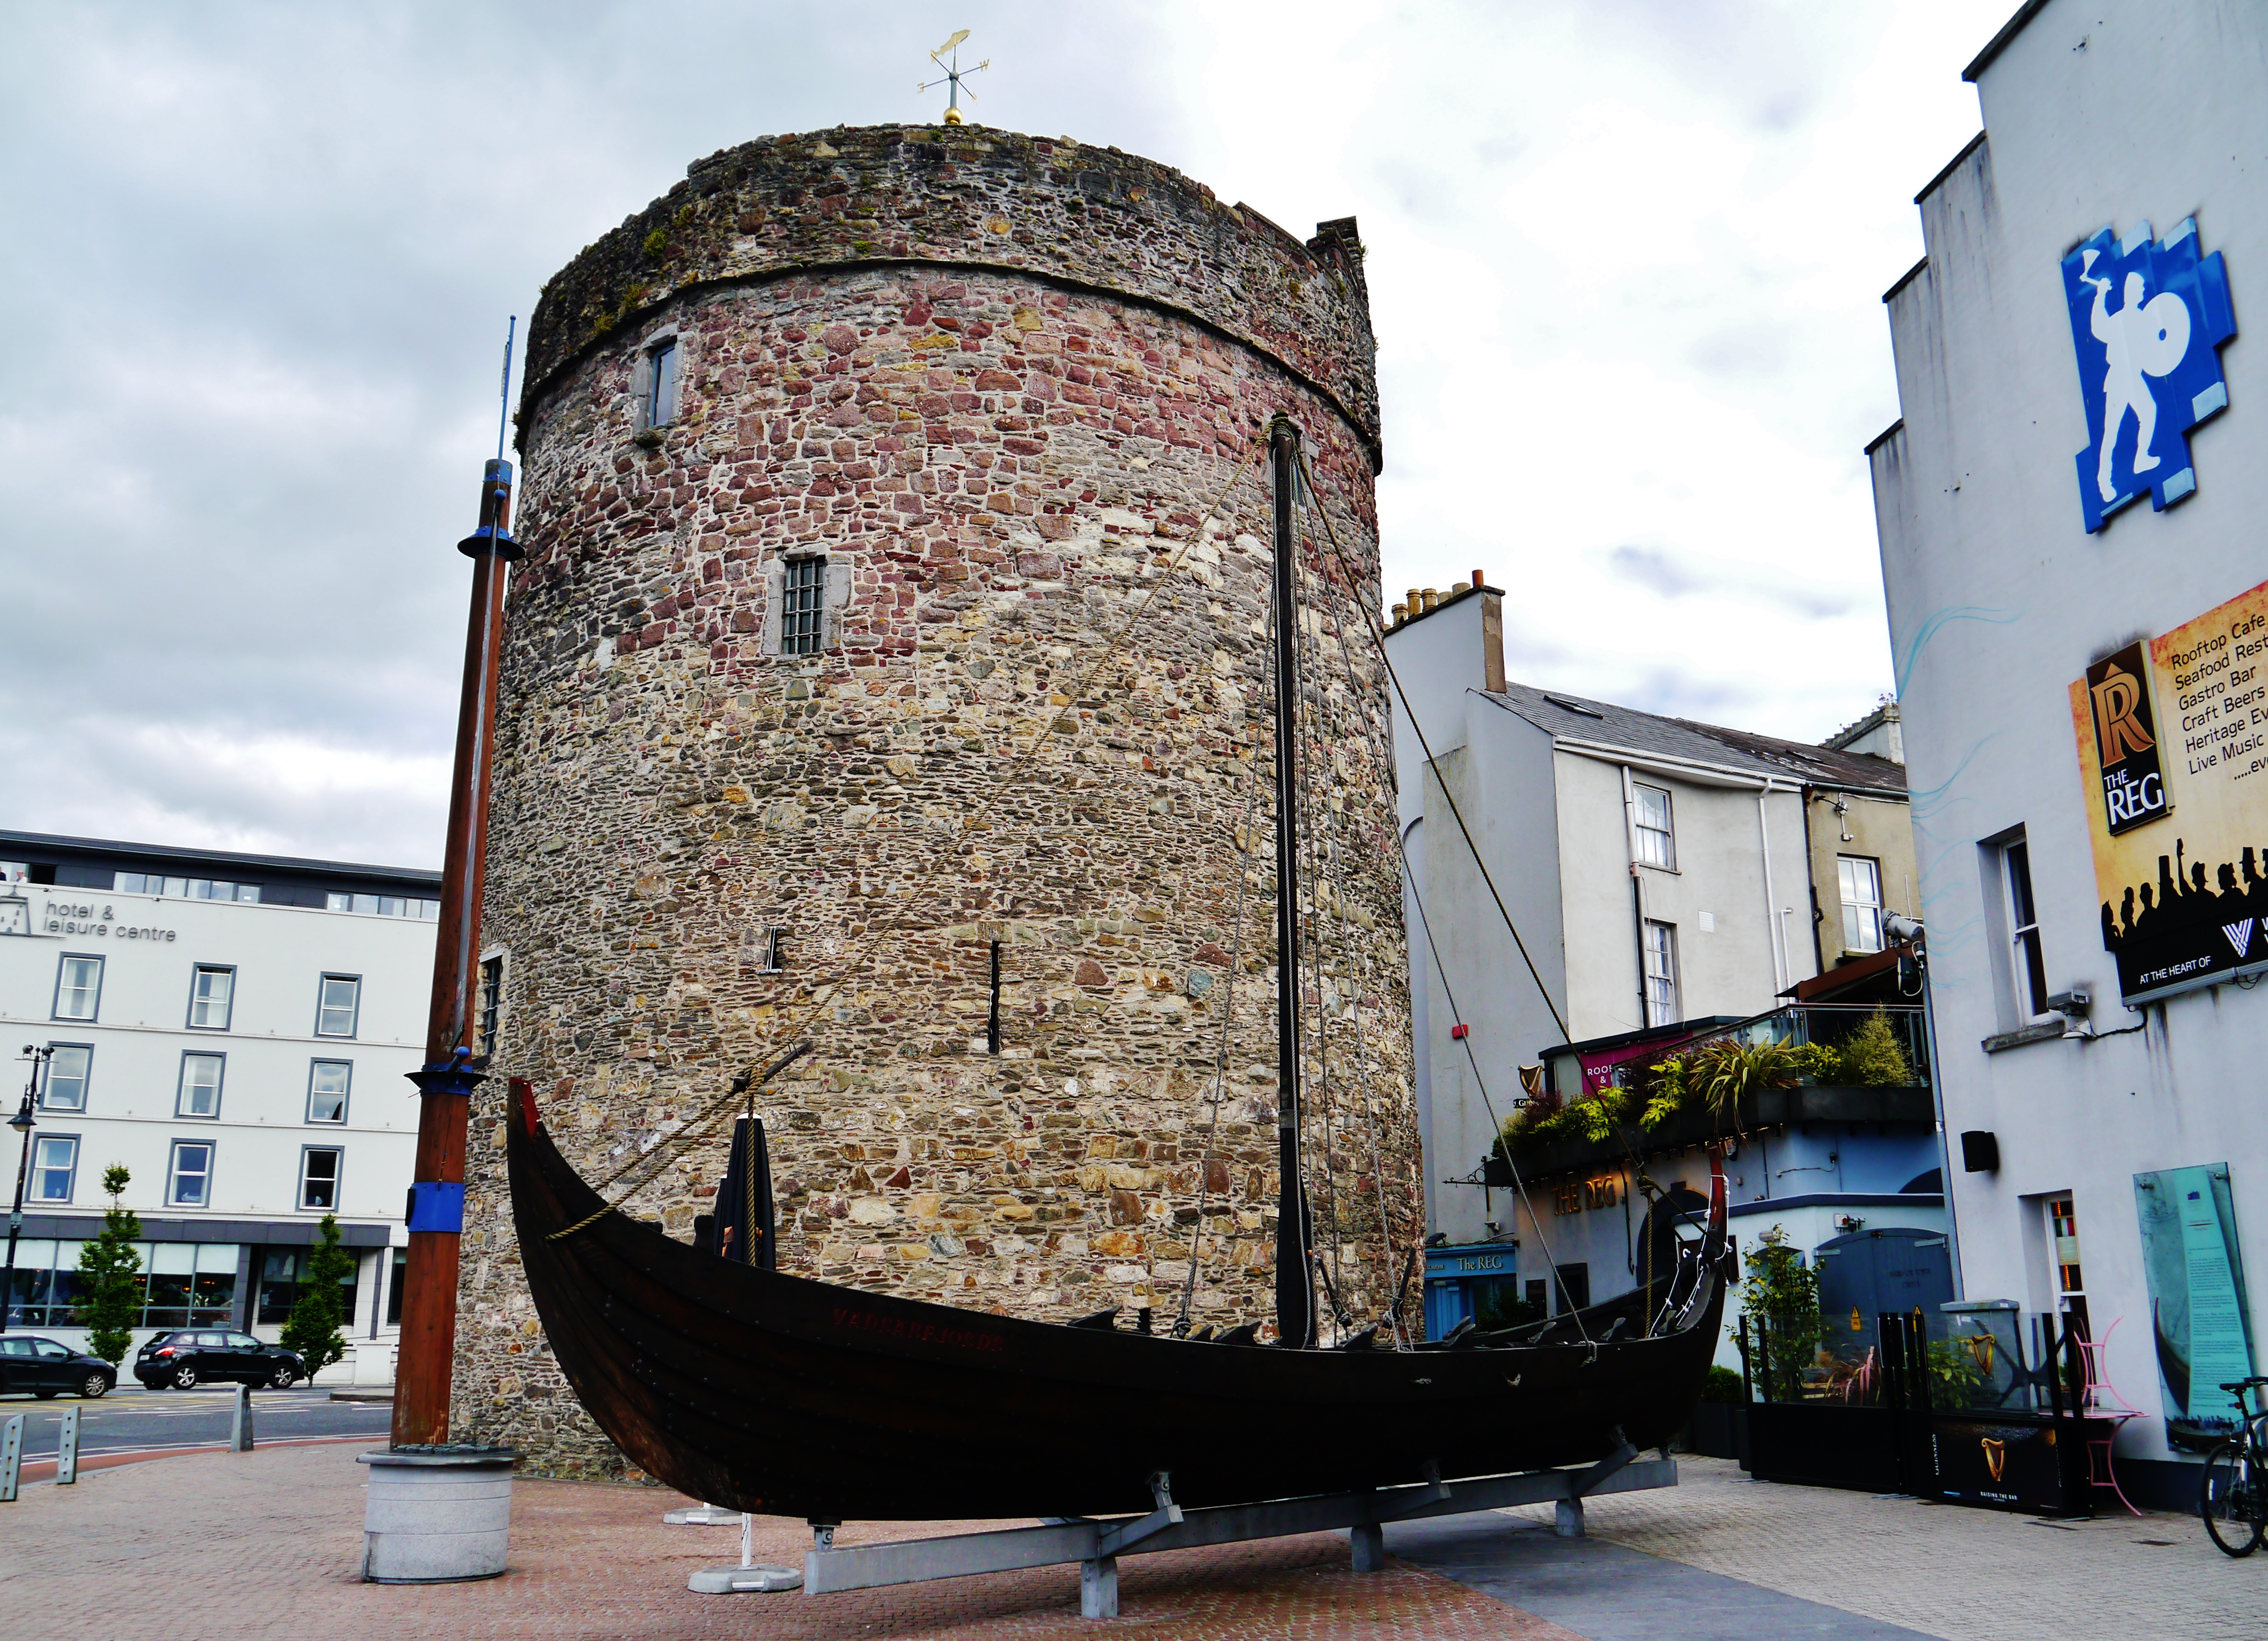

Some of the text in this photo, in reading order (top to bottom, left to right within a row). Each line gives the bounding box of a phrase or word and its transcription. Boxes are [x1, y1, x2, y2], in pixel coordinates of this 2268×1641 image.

[2171, 614, 2266, 670] Rooftop Cafe
[2175, 652, 2230, 691] Seafood
[2179, 666, 2256, 711] Gastro Bar
[2182, 686, 2266, 732] Craft Beers
[2185, 719, 2246, 754] Heritage
[2188, 733, 2264, 775] Live Music
[2104, 769, 2129, 790] THE
[2107, 773, 2164, 825] REG
[46, 900, 114, 920] hotel &
[43, 916, 176, 942] leisure centre
[2140, 955, 2211, 985] AT THE HEART OF
[1600, 1075, 1607, 1084] &
[1550, 1176, 1617, 1216] THE REG
[1457, 1258, 1477, 1271] The
[1478, 1255, 1503, 1270] REG
